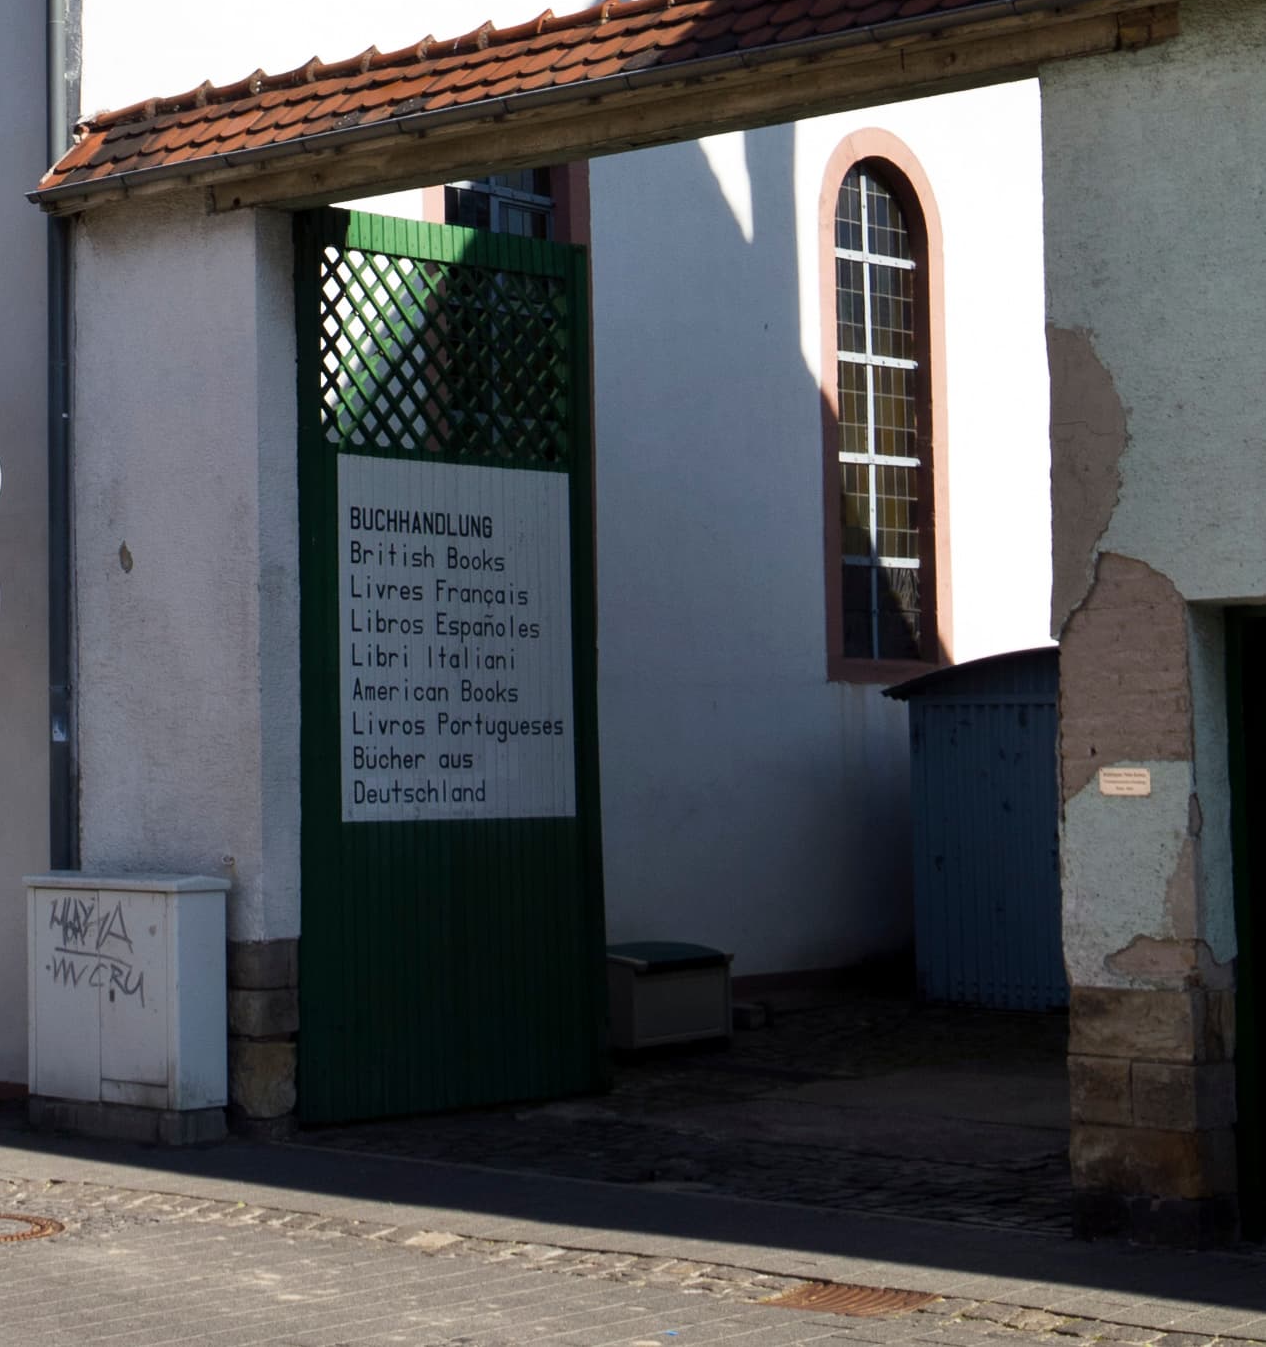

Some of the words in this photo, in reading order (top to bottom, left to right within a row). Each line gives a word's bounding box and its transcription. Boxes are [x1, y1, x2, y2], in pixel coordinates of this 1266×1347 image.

[350, 506, 493, 538] BUCHHANDLUNG
[350, 540, 435, 568] British
[447, 546, 506, 572] Books
[351, 575, 424, 601] Livres
[436, 579, 529, 606] Français
[351, 609, 424, 635] Libros
[436, 612, 540, 643] Españoles
[352, 643, 409, 668] Libri
[428, 645, 515, 671] Italiani
[352, 677, 449, 702] American
[461, 679, 519, 703] Books
[352, 711, 425, 736] Livros
[438, 712, 564, 743] Portugueses
[353, 745, 426, 770] Bücher
[439, 753, 474, 769] aus
[354, 779, 486, 804] Deutschland
